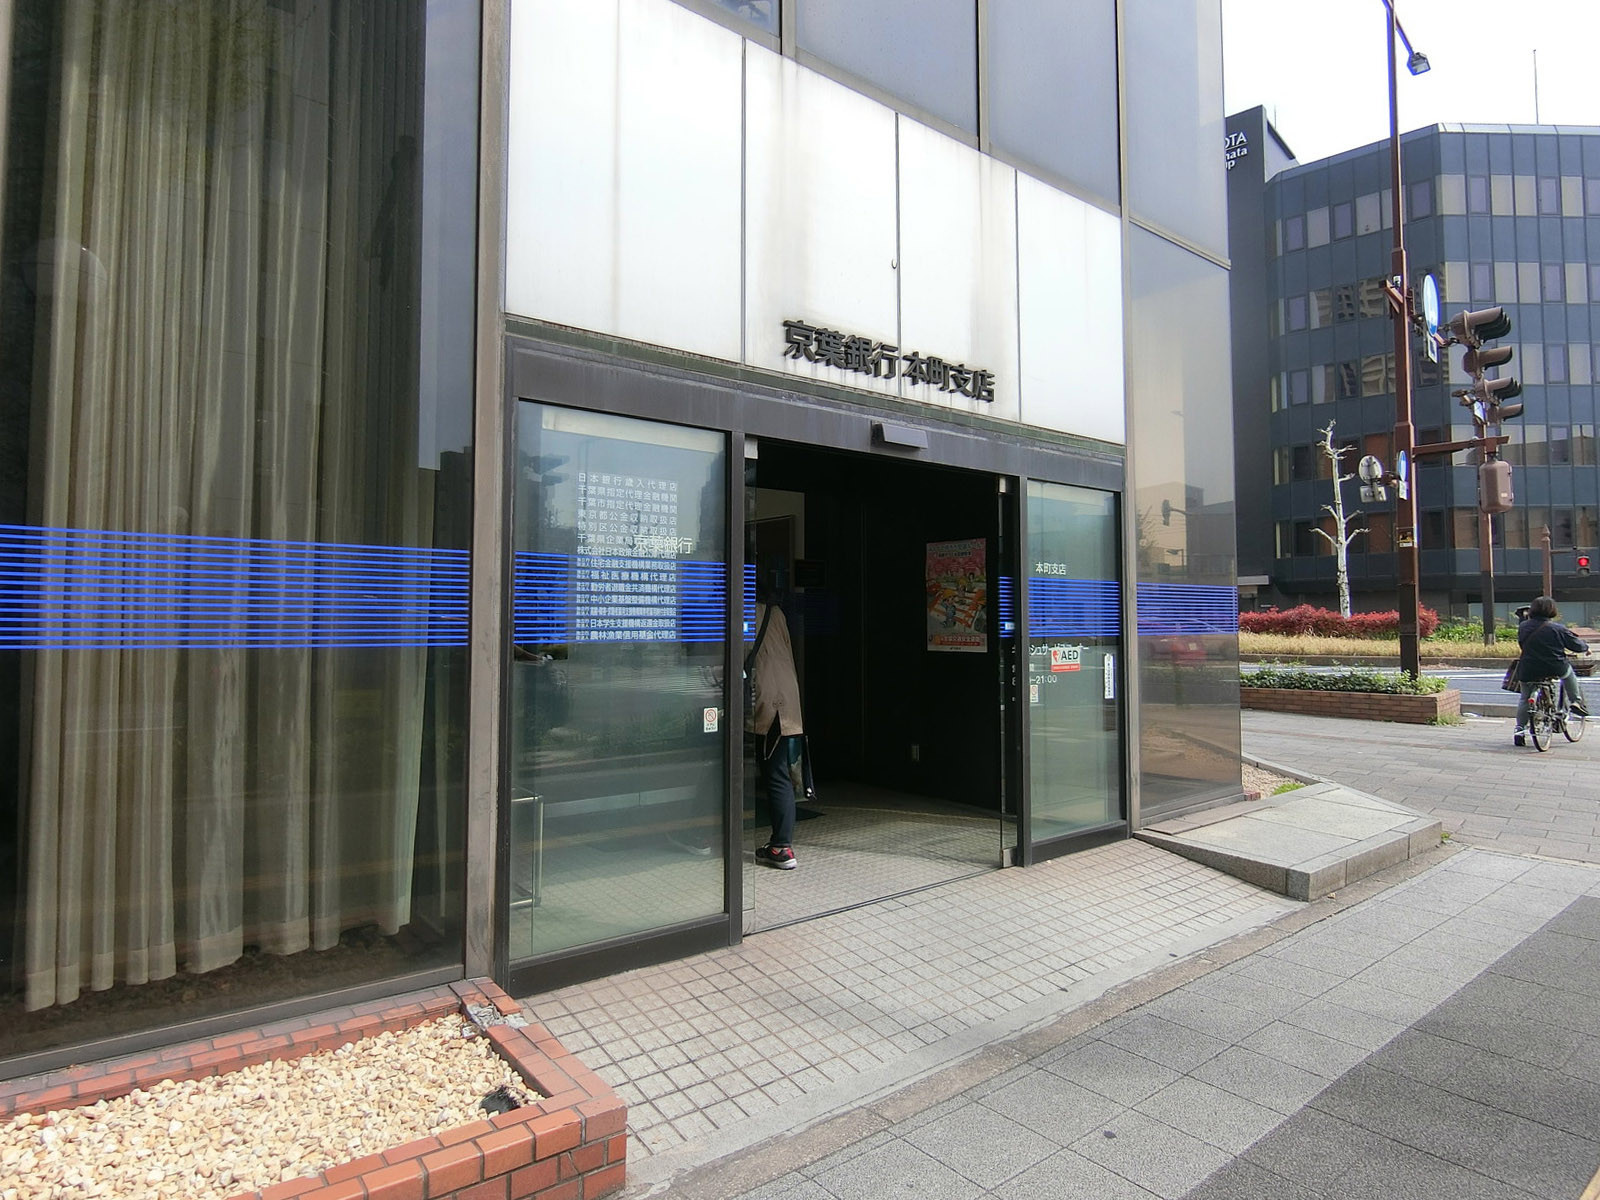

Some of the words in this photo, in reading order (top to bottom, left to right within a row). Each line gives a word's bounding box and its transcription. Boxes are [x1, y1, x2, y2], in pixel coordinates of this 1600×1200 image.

[782, 319, 995, 403] 京葉銀行本町支店
[578, 472, 678, 491] 日本銀行歳入代理店
[577, 484, 678, 503] 千葉県指定代理金融機関
[577, 496, 678, 514] 千葉市指定代理金融機関
[577, 509, 677, 525] 東京都公金収納取扱店
[577, 520, 677, 536] 特別区公金収納取扱店
[632, 533, 693, 555] 京葉銀行
[1035, 561, 1067, 575] 本町支店
[1061, 650, 1079, 661] AED
